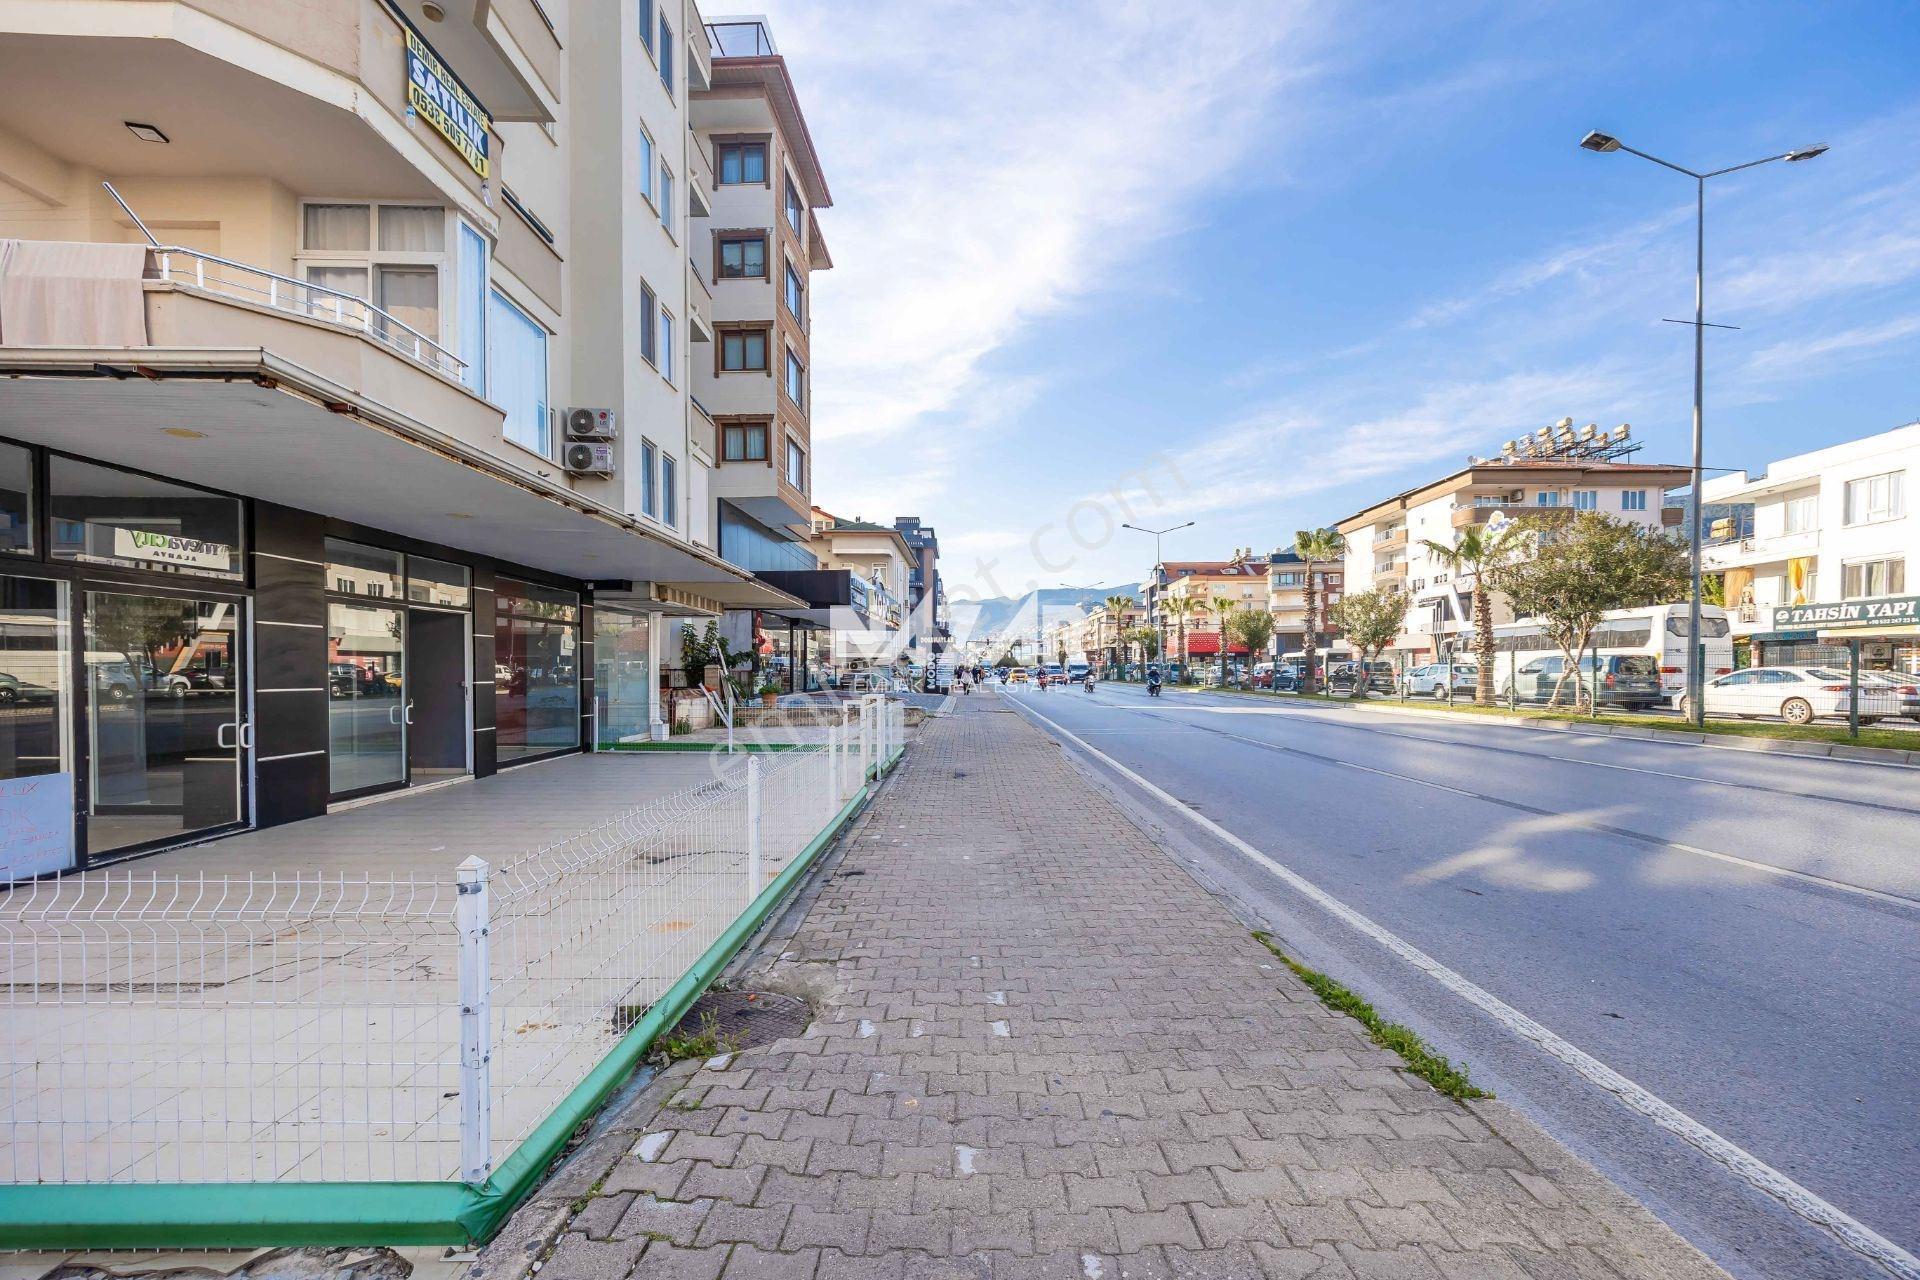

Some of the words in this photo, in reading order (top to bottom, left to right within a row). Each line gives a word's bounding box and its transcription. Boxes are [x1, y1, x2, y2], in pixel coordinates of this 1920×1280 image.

[412, 58, 485, 155] SATILIK
[443, 116, 461, 147] 505
[1790, 603, 1861, 622] TAHSİN
[1866, 601, 1916, 618] YAPI
